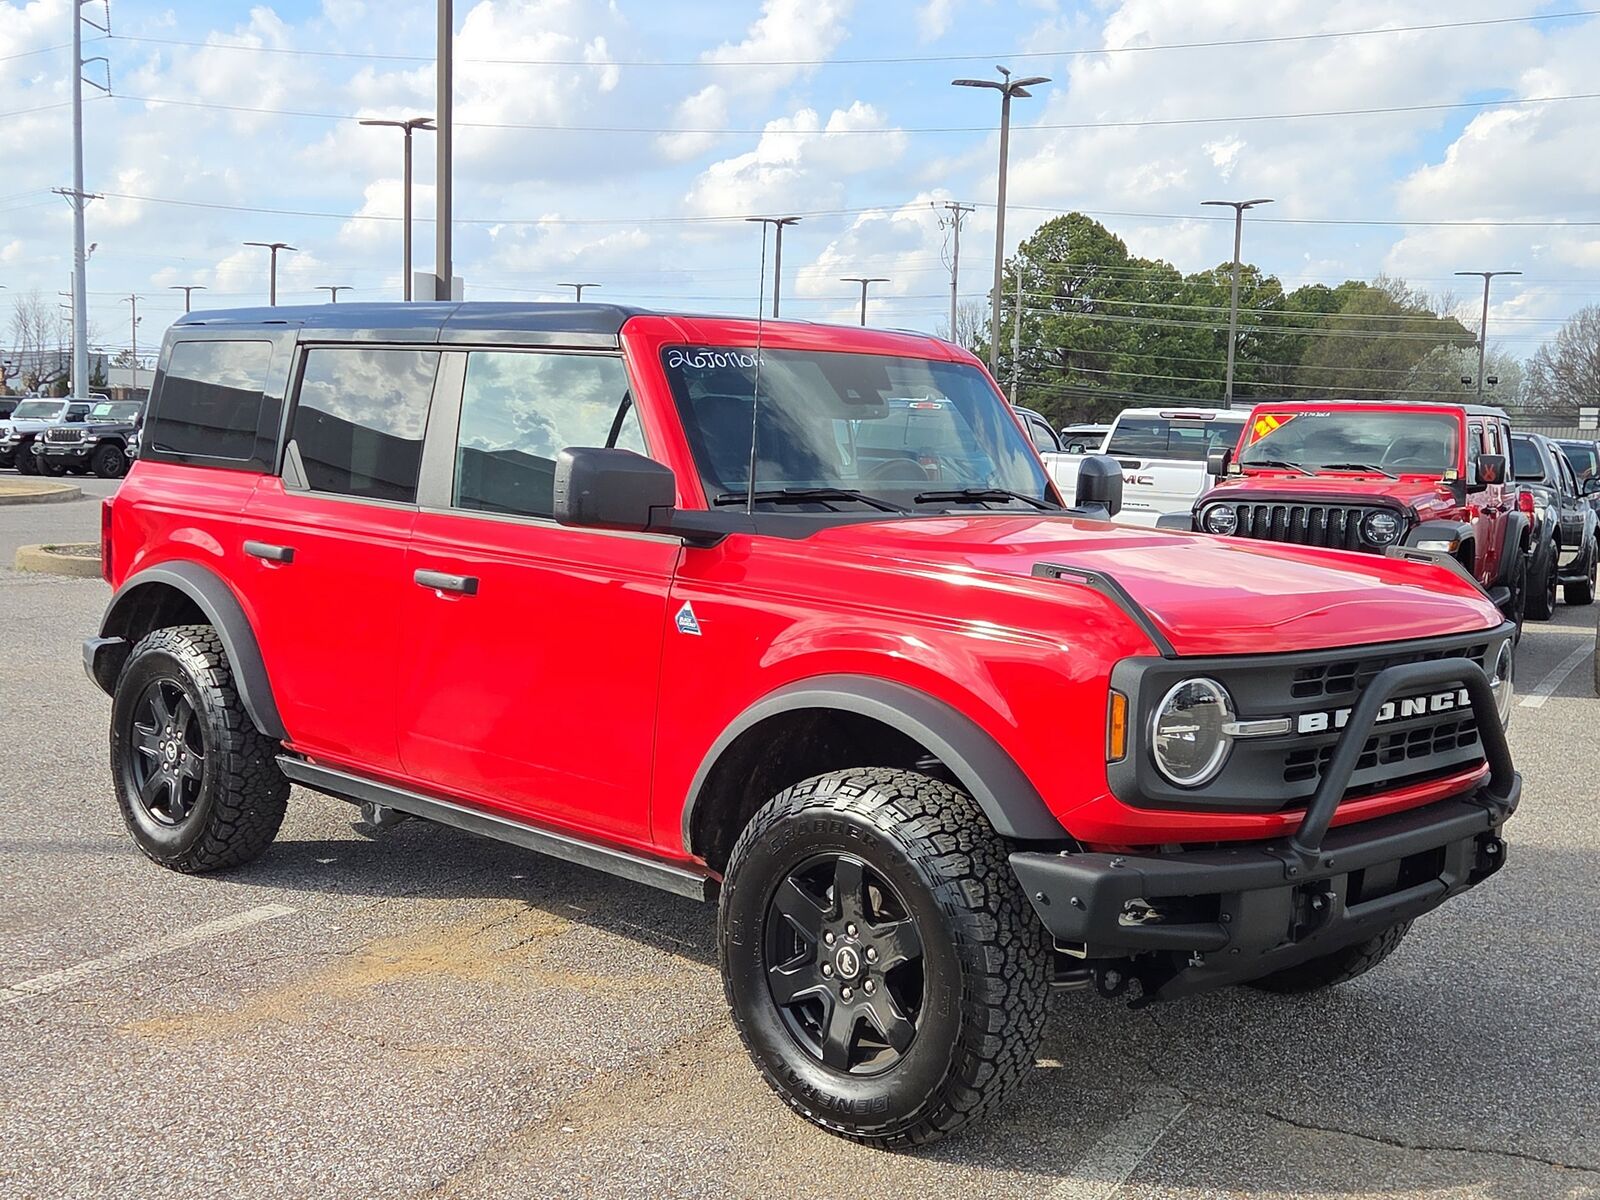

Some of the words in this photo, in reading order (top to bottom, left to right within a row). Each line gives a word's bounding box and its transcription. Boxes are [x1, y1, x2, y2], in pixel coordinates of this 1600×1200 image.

[1254, 415, 1281, 437] 21
[1122, 474, 1154, 486] MC
[773, 1053, 890, 1115] GENERAL
